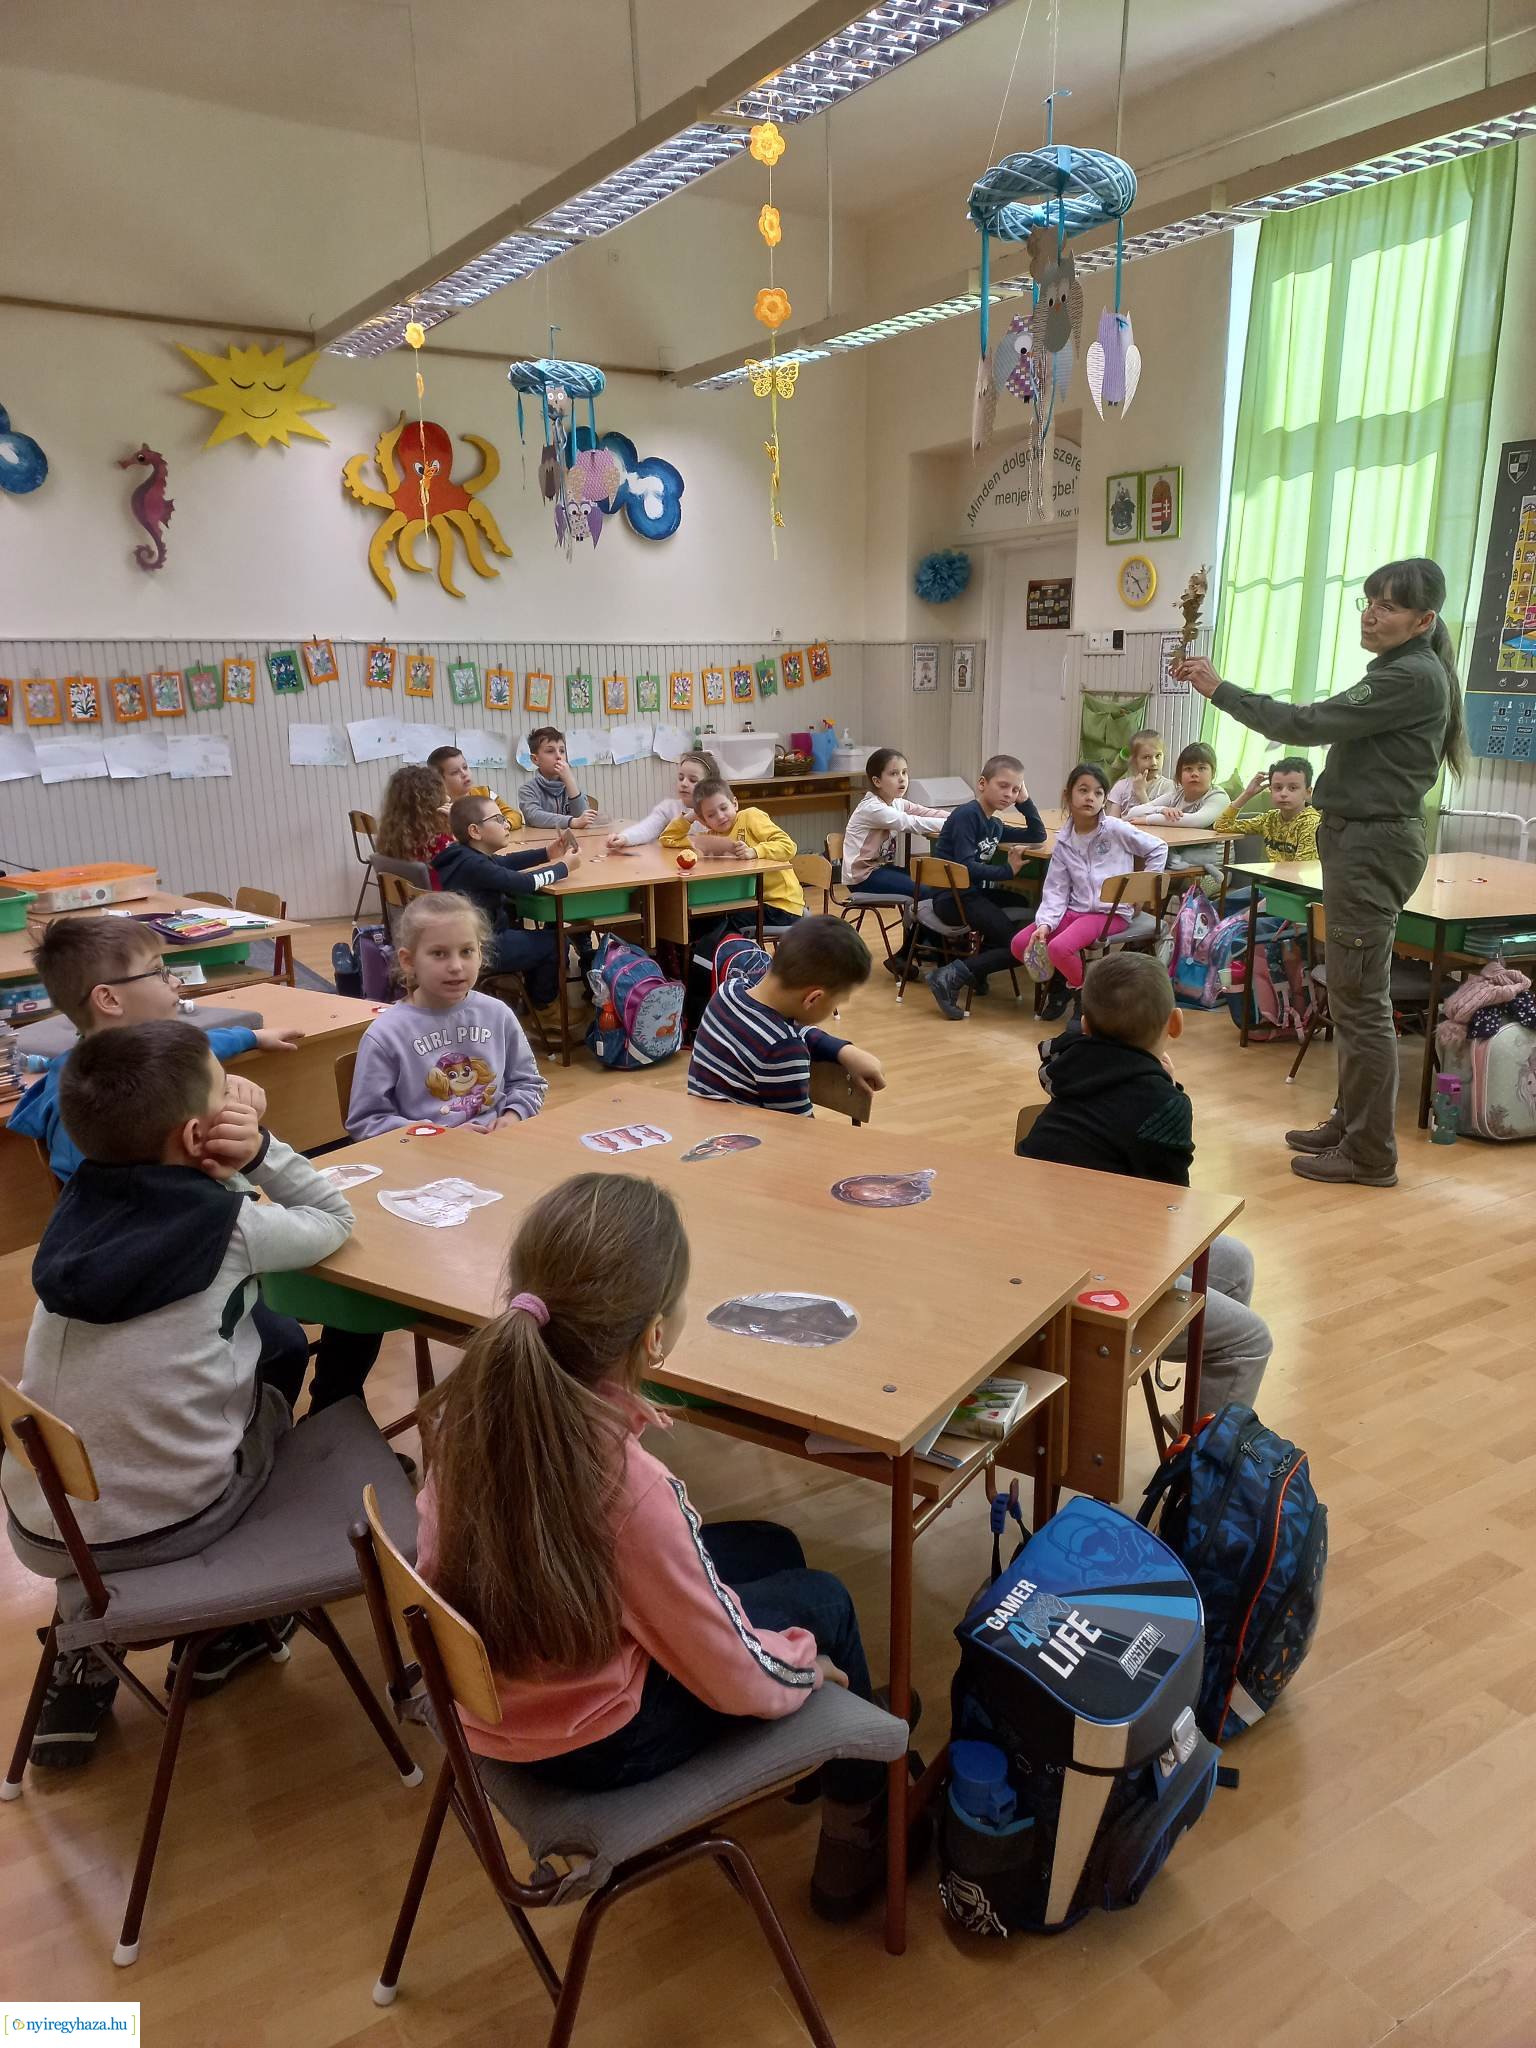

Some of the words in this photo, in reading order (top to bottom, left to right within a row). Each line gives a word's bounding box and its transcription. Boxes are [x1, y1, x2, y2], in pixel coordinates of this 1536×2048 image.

[413, 1029, 452, 1056] GIRL
[456, 1025, 492, 1043] PUP
[985, 1579, 1038, 1631] GAMER
[1007, 1622, 1044, 1649] 4
[1038, 1610, 1102, 1679] LIFE
